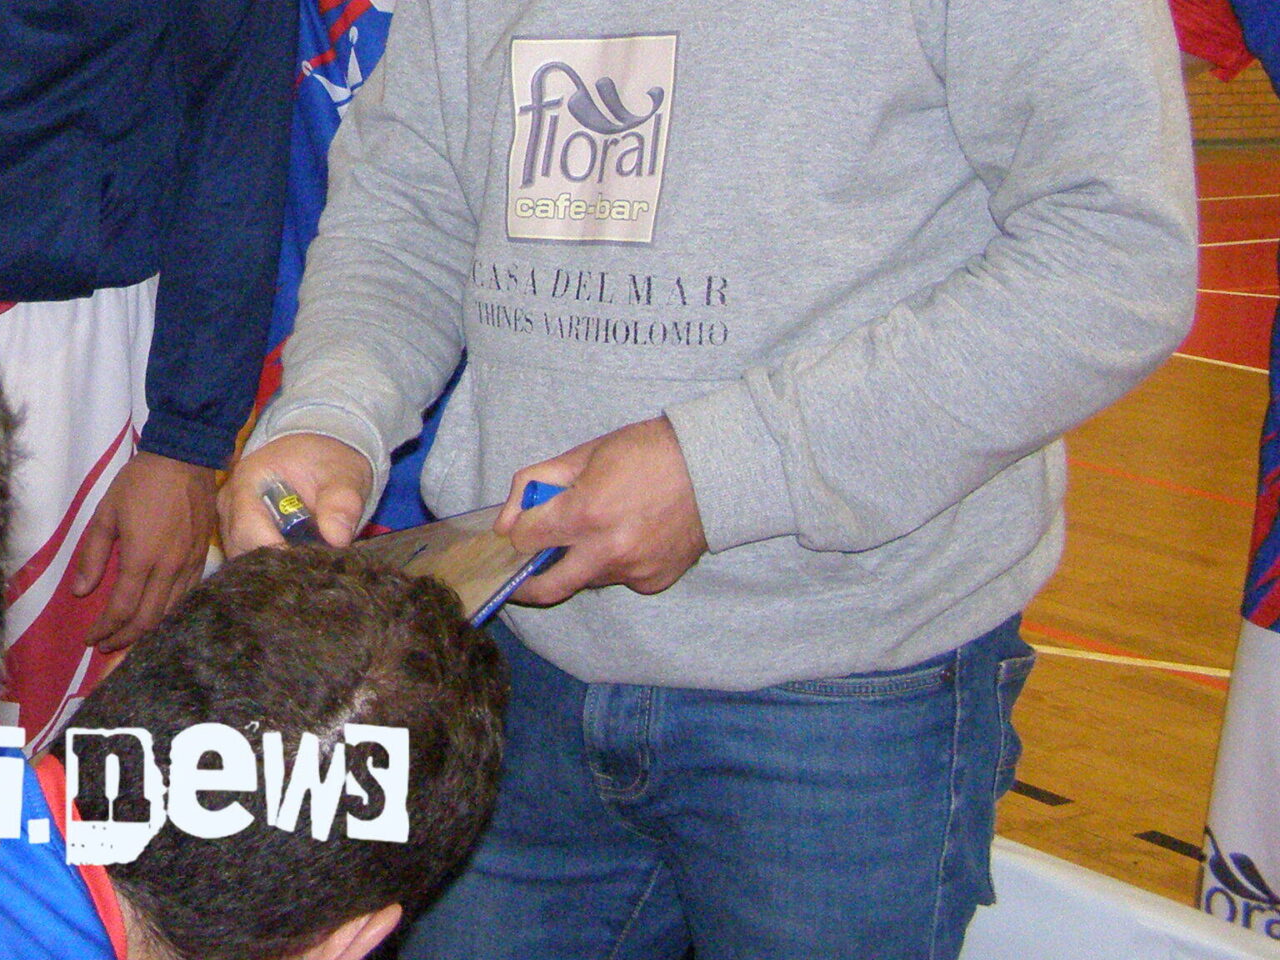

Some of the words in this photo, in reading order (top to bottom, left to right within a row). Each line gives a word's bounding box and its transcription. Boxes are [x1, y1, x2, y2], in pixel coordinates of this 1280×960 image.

[517, 60, 664, 190] floral
[514, 192, 650, 222] cafe-bar
[472, 258, 537, 296] CASA
[551, 267, 614, 304] DEL
[627, 273, 729, 307] MAR
